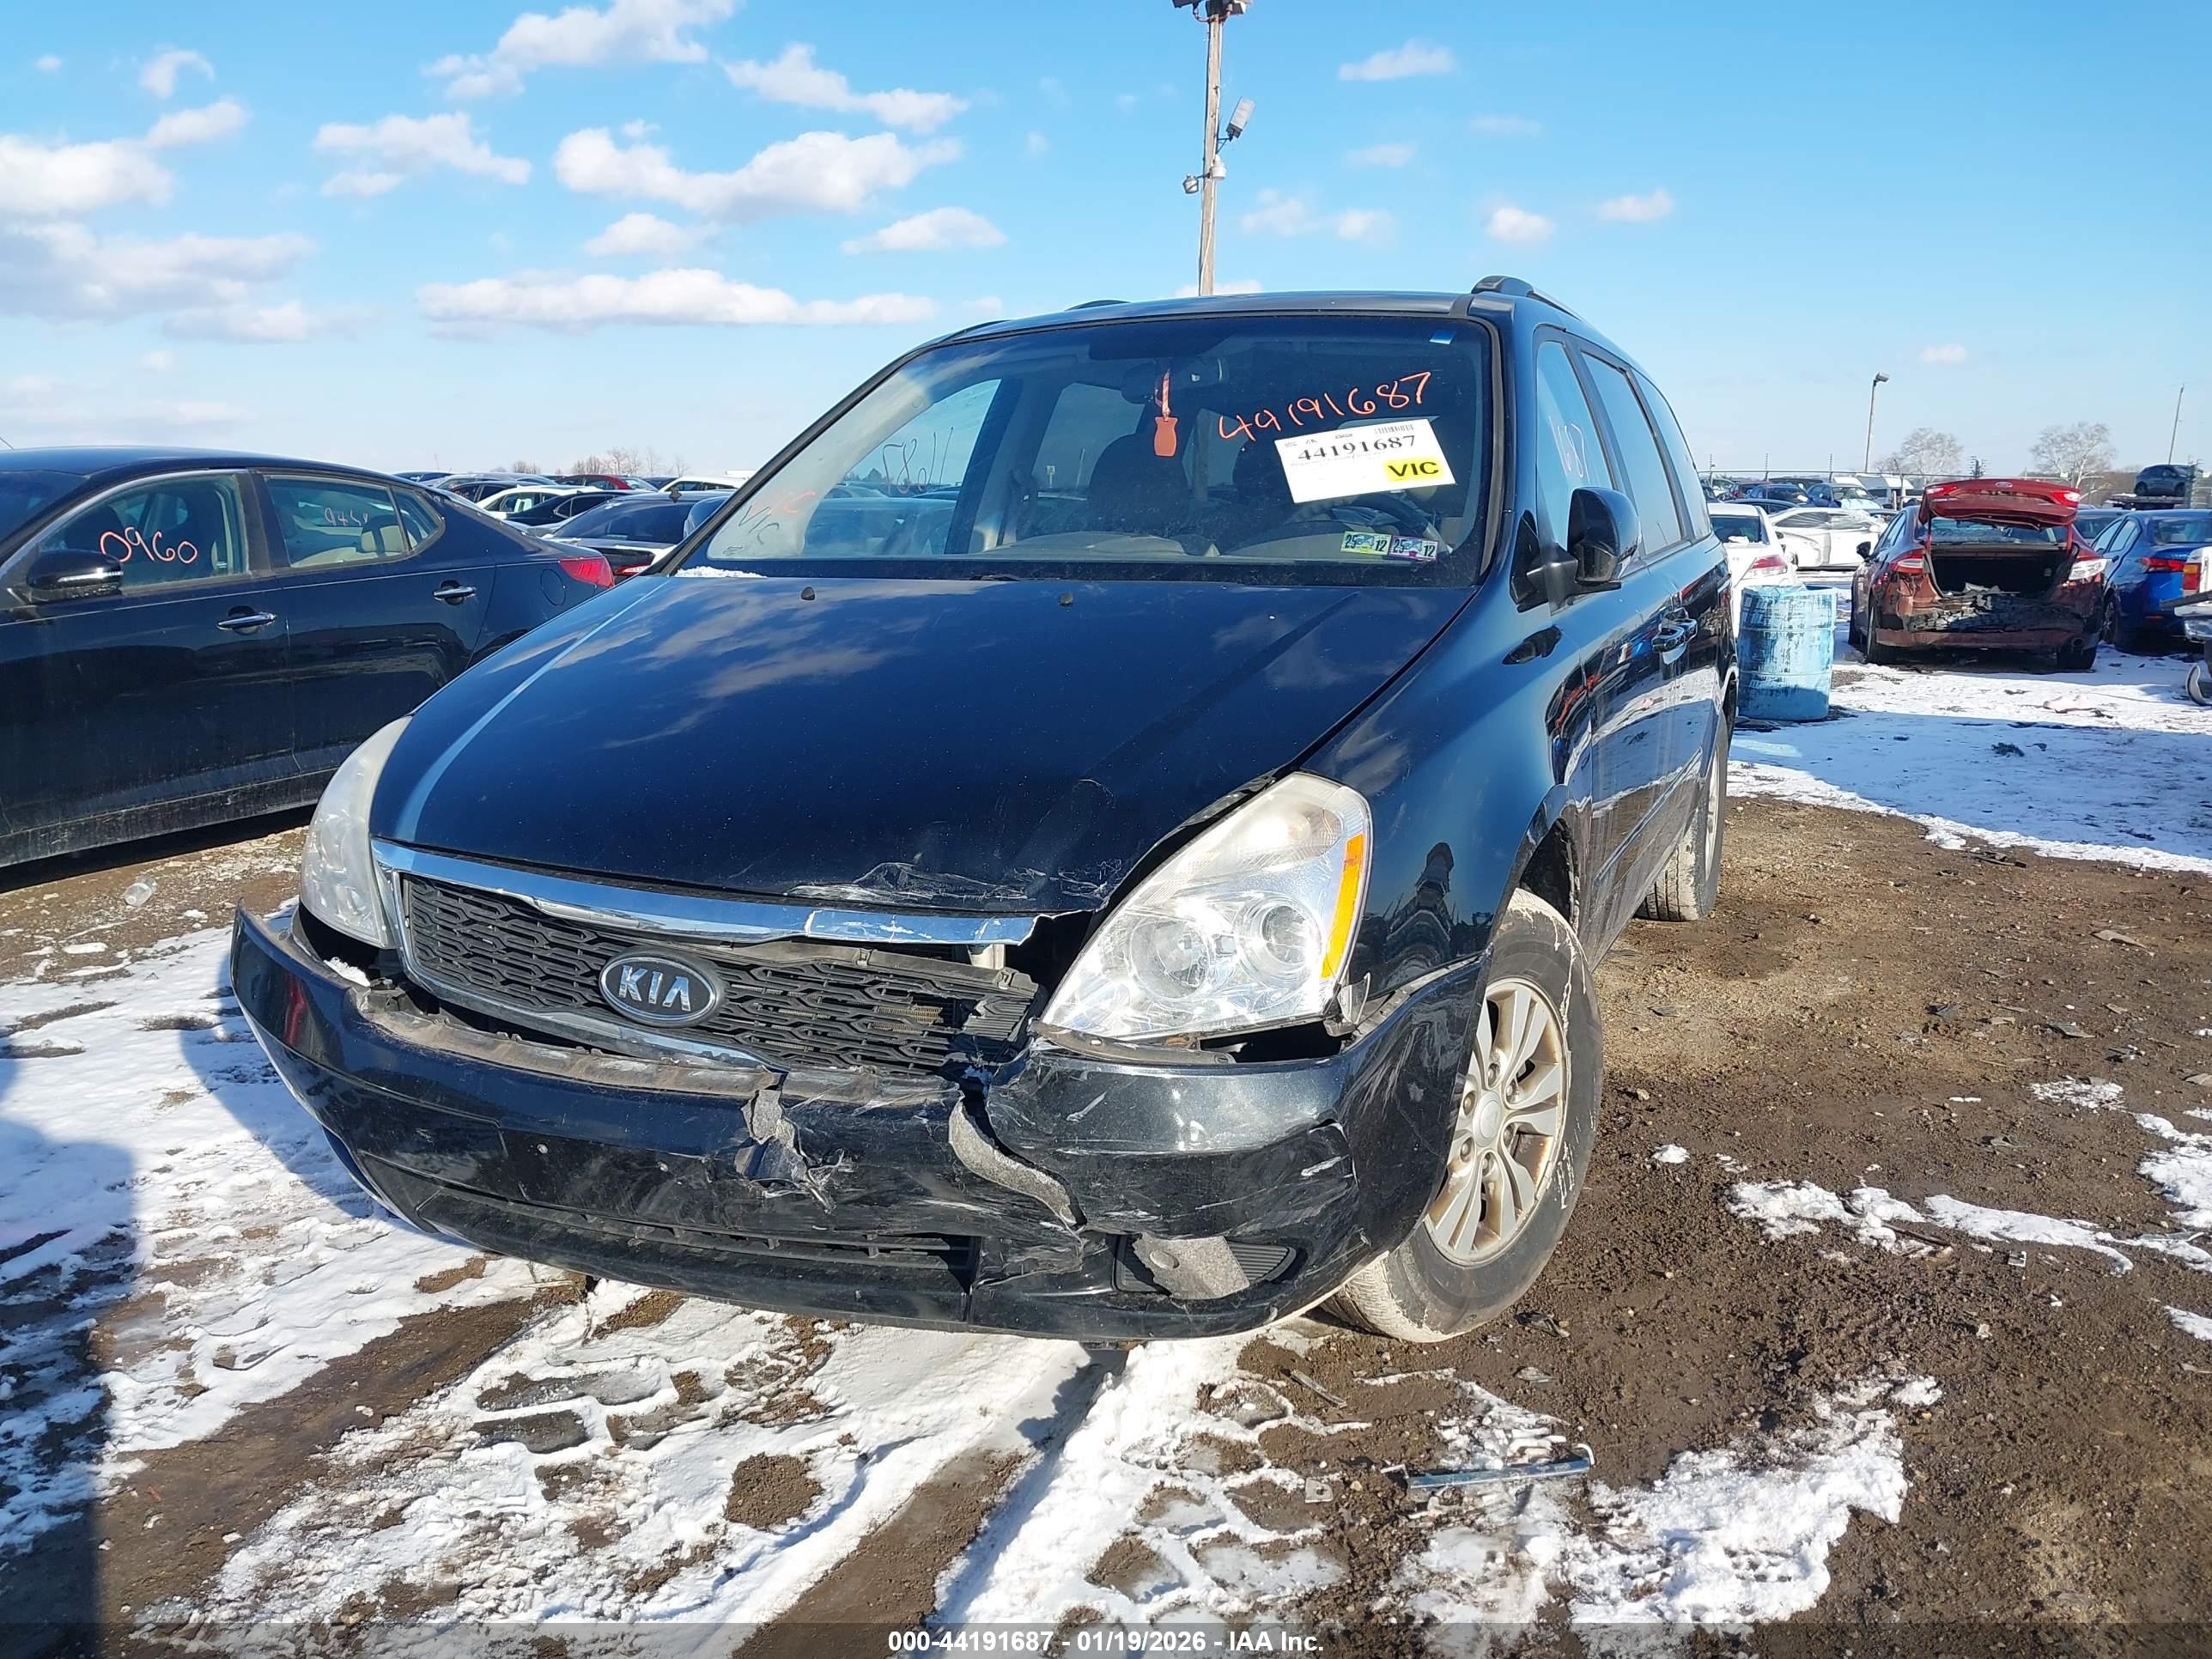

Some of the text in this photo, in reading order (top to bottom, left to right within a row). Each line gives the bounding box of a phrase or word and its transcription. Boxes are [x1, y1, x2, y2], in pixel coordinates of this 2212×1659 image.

[1297, 434, 1416, 460] 44191687
[1388, 461, 1439, 477] VIC
[100, 526, 198, 563] 0960
[1345, 534, 1388, 552] 25 12
[1393, 538, 1436, 558] 25 12
[618, 964, 691, 1012] KIA
